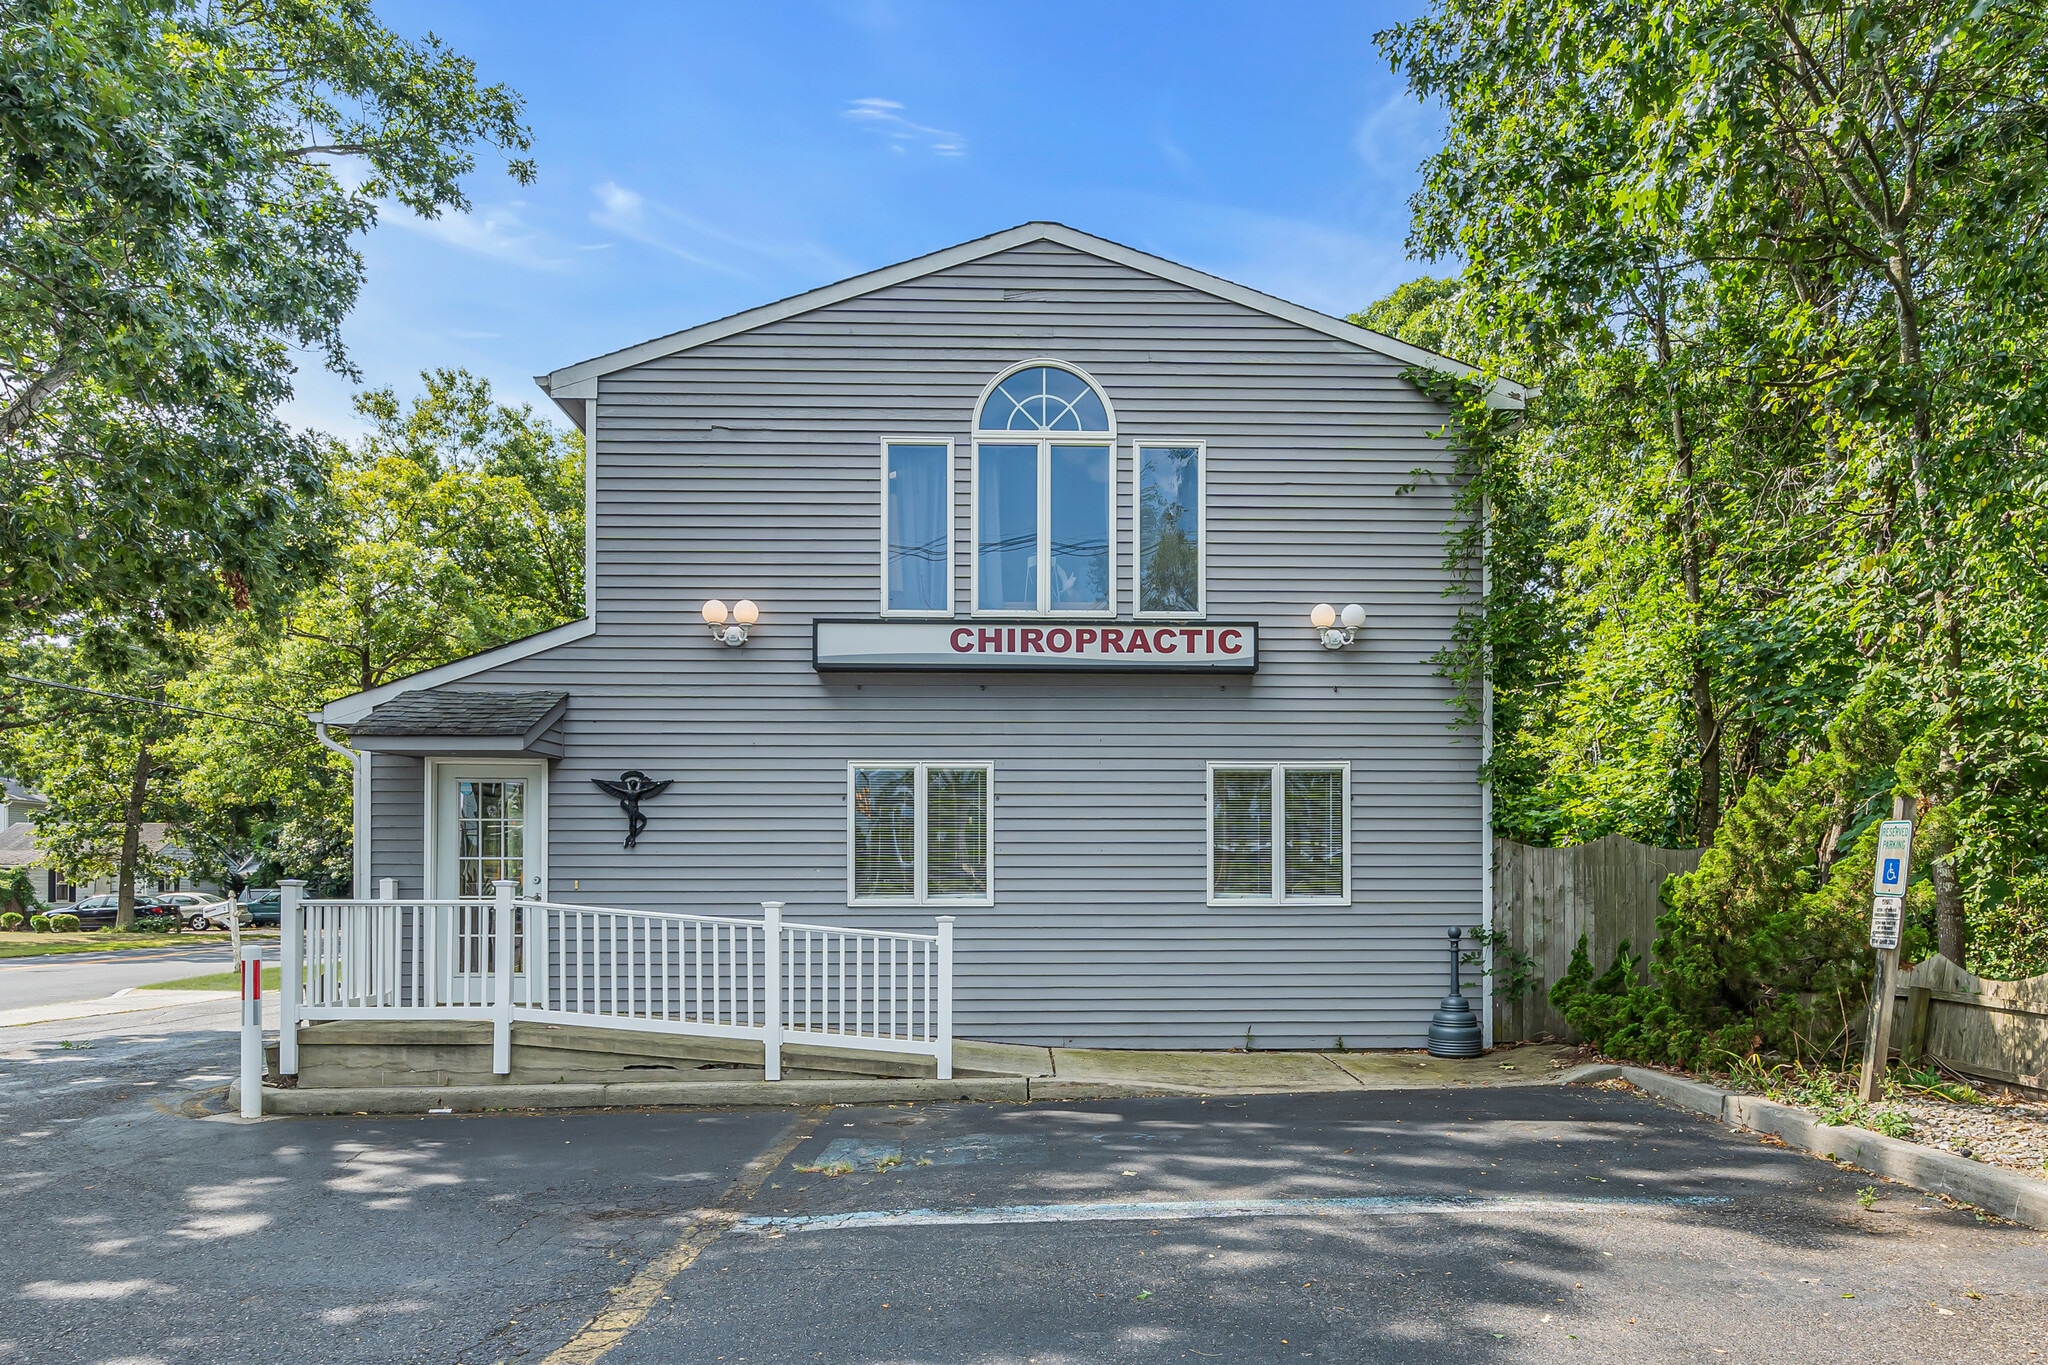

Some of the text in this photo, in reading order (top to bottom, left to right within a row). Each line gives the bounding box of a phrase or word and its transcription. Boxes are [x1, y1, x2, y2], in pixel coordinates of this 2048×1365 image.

[949, 627, 1243, 654] CHIROPRACTIC
[1882, 827, 1909, 837] RESERVED
[1882, 840, 1906, 850] PARKING
